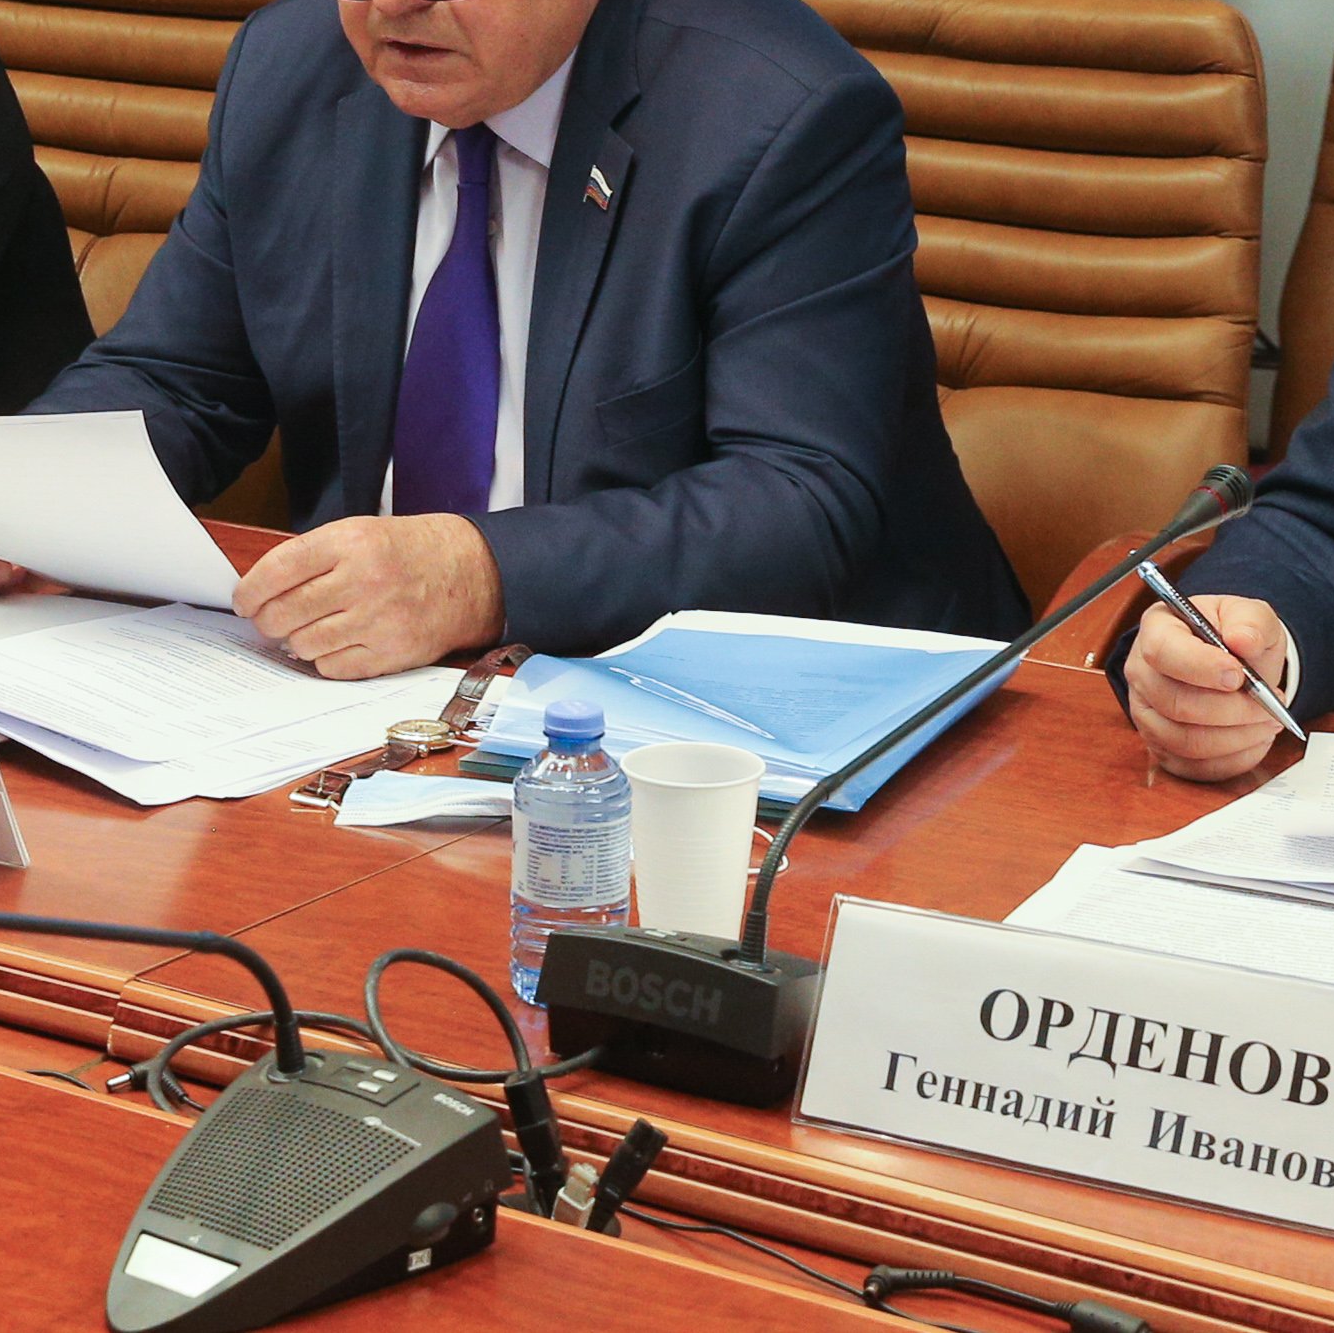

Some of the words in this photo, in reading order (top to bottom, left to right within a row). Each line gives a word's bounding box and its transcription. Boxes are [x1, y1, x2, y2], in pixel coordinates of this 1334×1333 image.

[585, 960, 723, 1024] BOSCH
[978, 987, 1333, 1107] ОРДЕНОВ
[433, 1093, 476, 1116] BOSCH
[880, 1050, 1116, 1139] Геннадий
